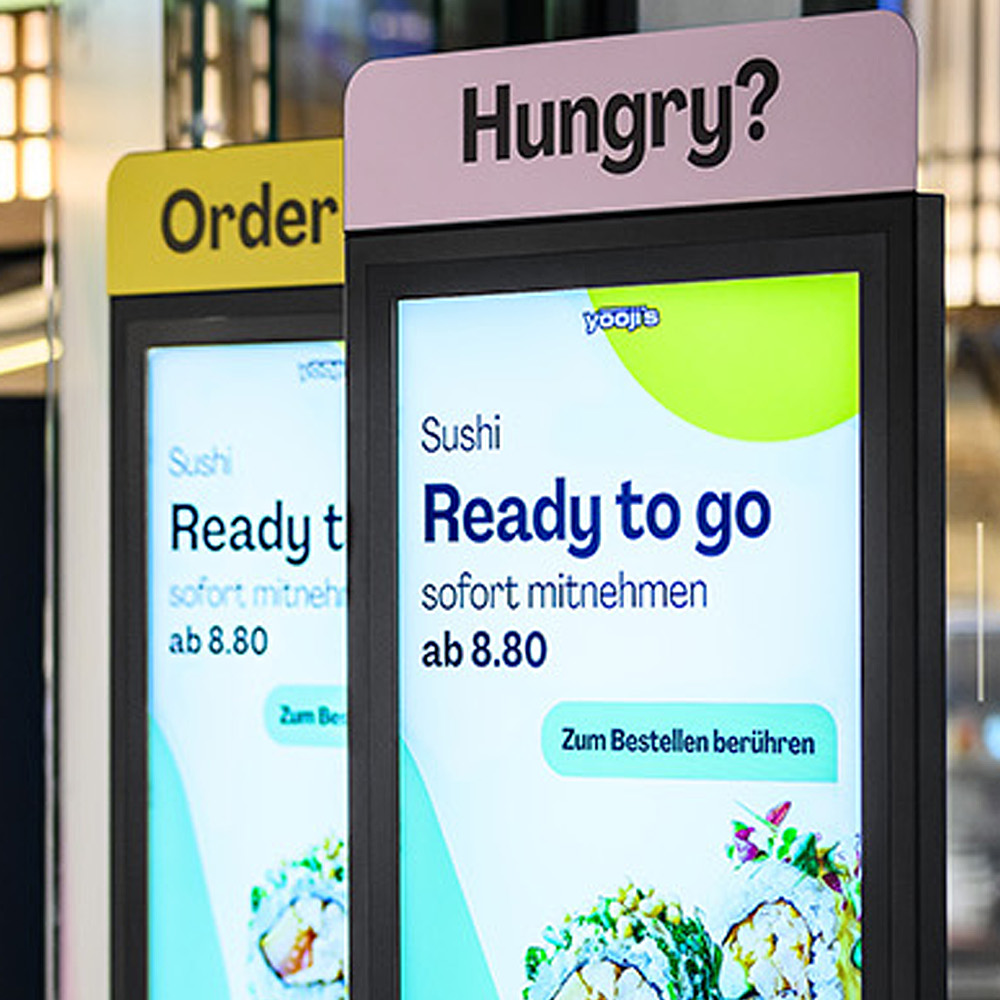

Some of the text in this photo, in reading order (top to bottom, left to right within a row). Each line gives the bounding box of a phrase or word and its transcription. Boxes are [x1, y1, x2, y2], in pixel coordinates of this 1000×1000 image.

[461, 56, 780, 175] Hungry?
[161, 181, 339, 254] Order
[421, 414, 501, 454] Sushi
[168, 445, 232, 478] Sushi
[171, 499, 311, 566] Ready
[423, 476, 772, 560] Ready to go
[169, 575, 246, 608] sofort
[421, 570, 707, 610] sofort mitnehmen
[168, 625, 269, 655] ab 8.80
[421, 630, 548, 669] ab 8.80
[278, 704, 315, 726] Zum
[561, 727, 815, 755] Zum Bestellen berühren
